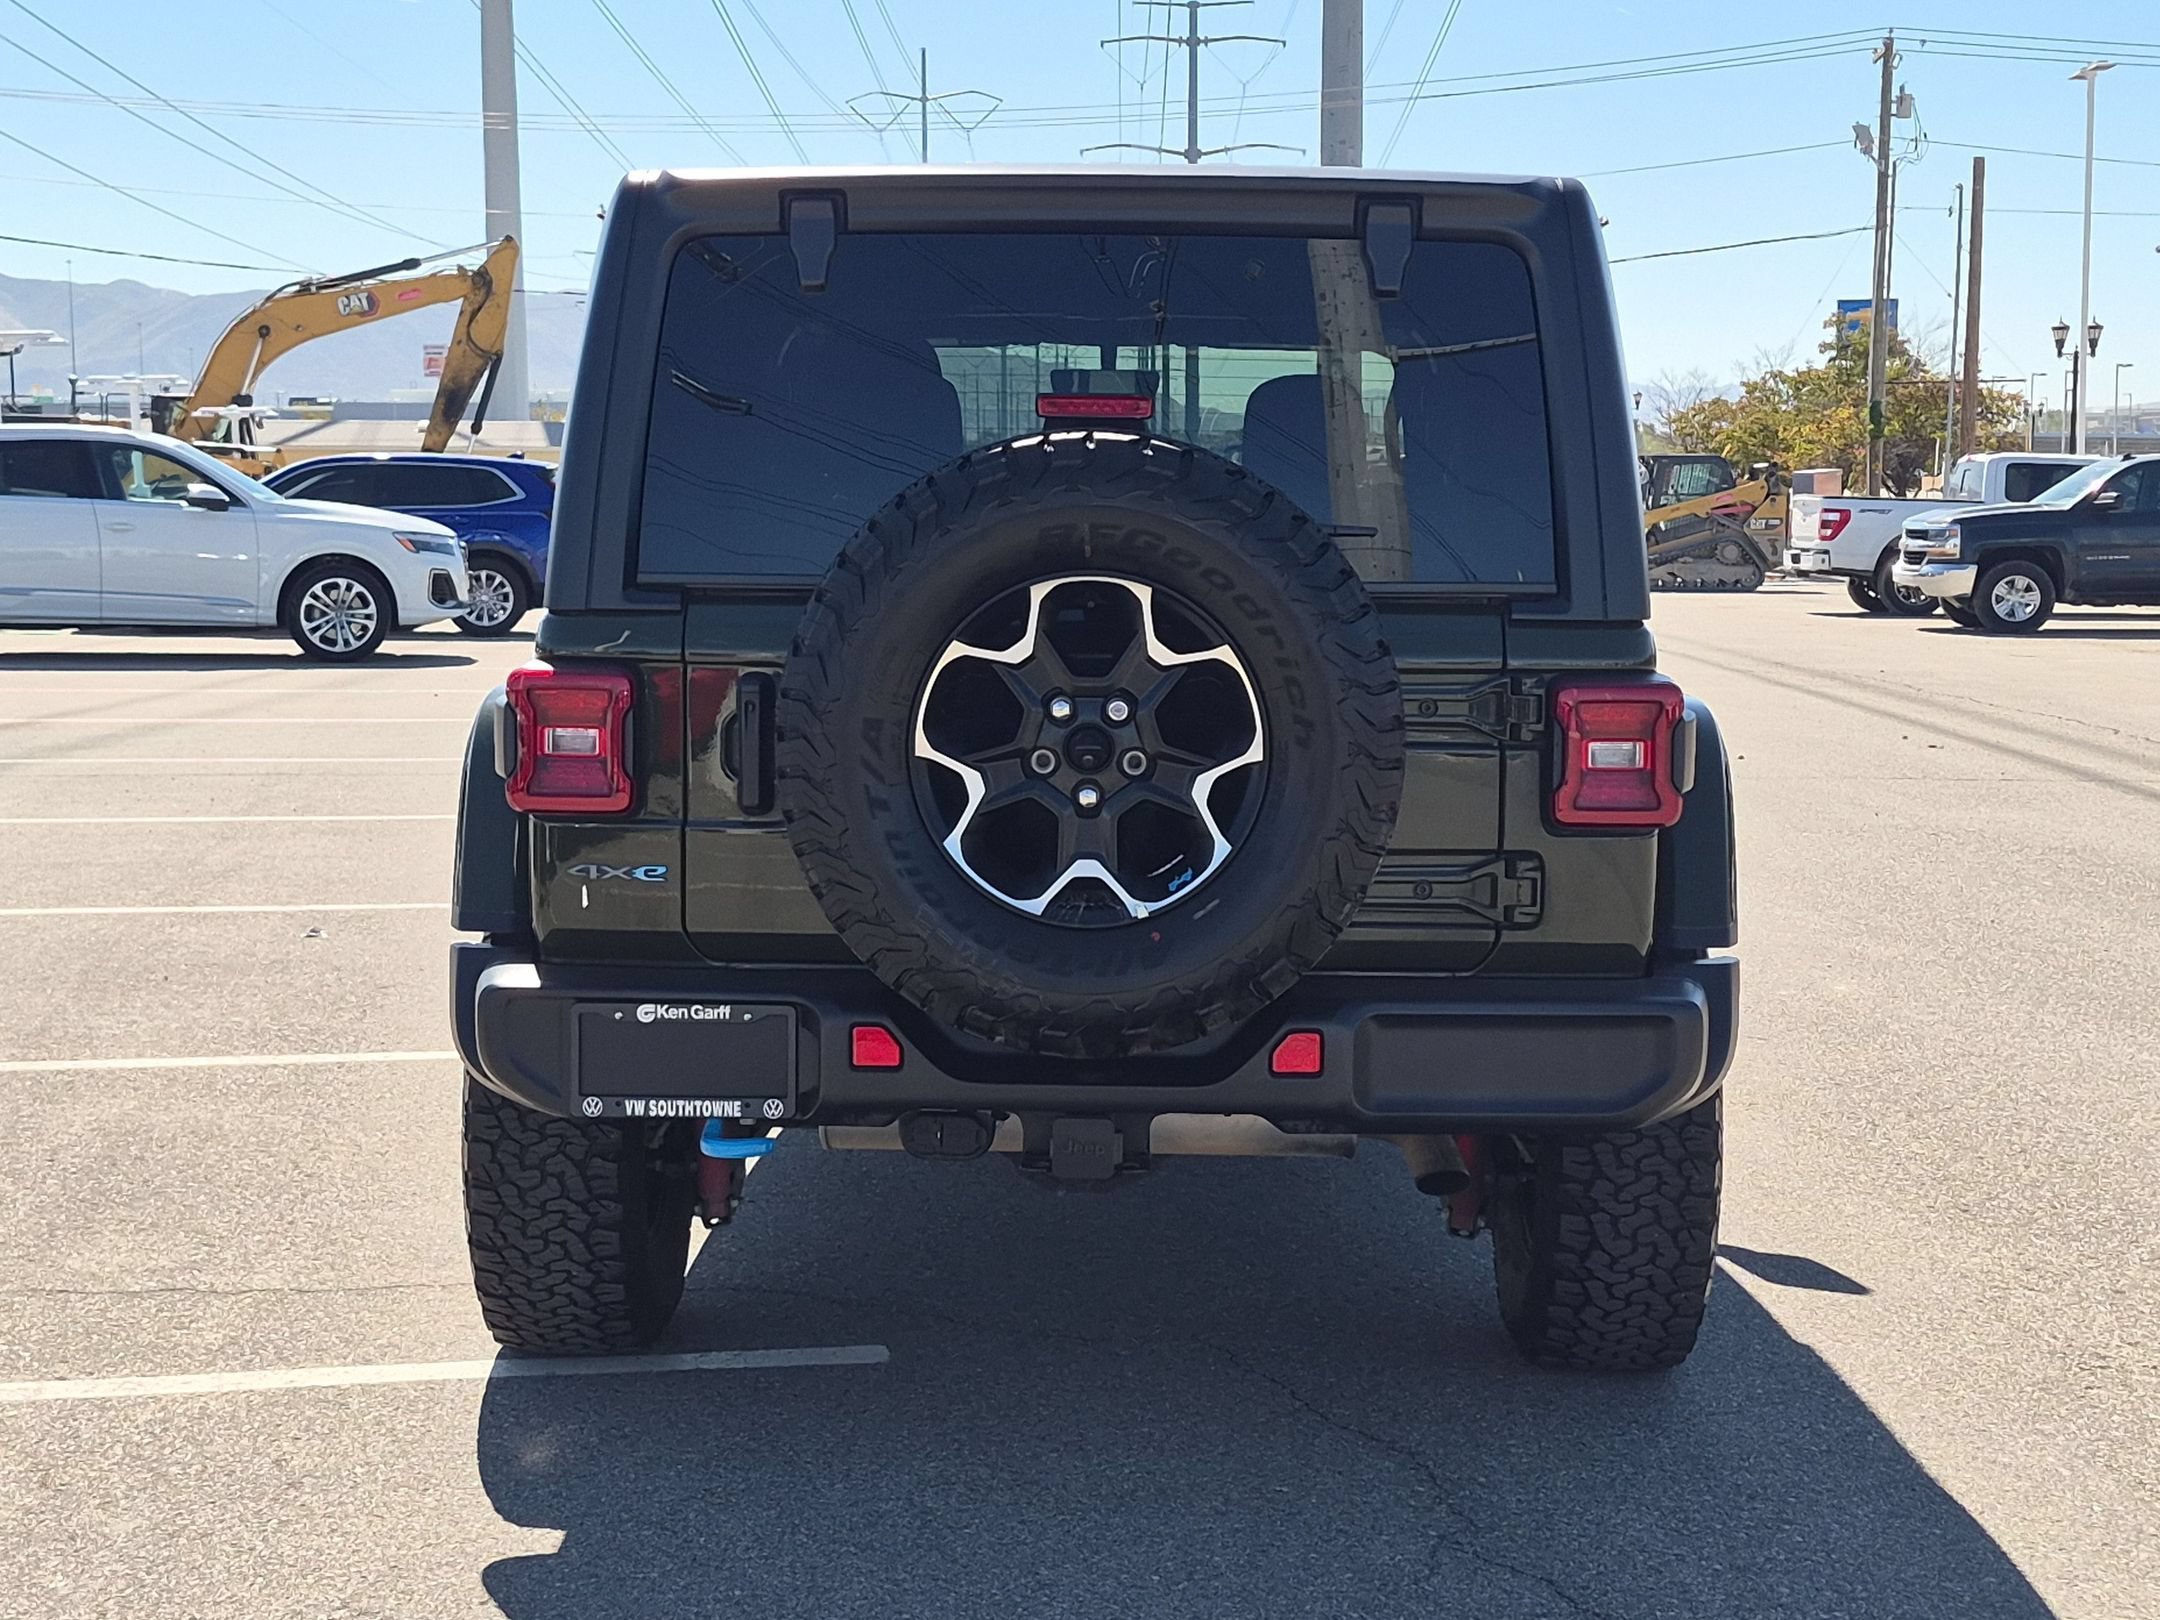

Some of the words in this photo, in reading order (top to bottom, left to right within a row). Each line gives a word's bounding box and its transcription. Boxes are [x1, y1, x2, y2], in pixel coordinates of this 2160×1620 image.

[337, 291, 370, 317] CAT
[656, 1004, 688, 1020] Ken
[690, 1004, 731, 1020] Garff
[625, 1100, 645, 1116] VW
[649, 1100, 742, 1117] SOUTHTOWNE
